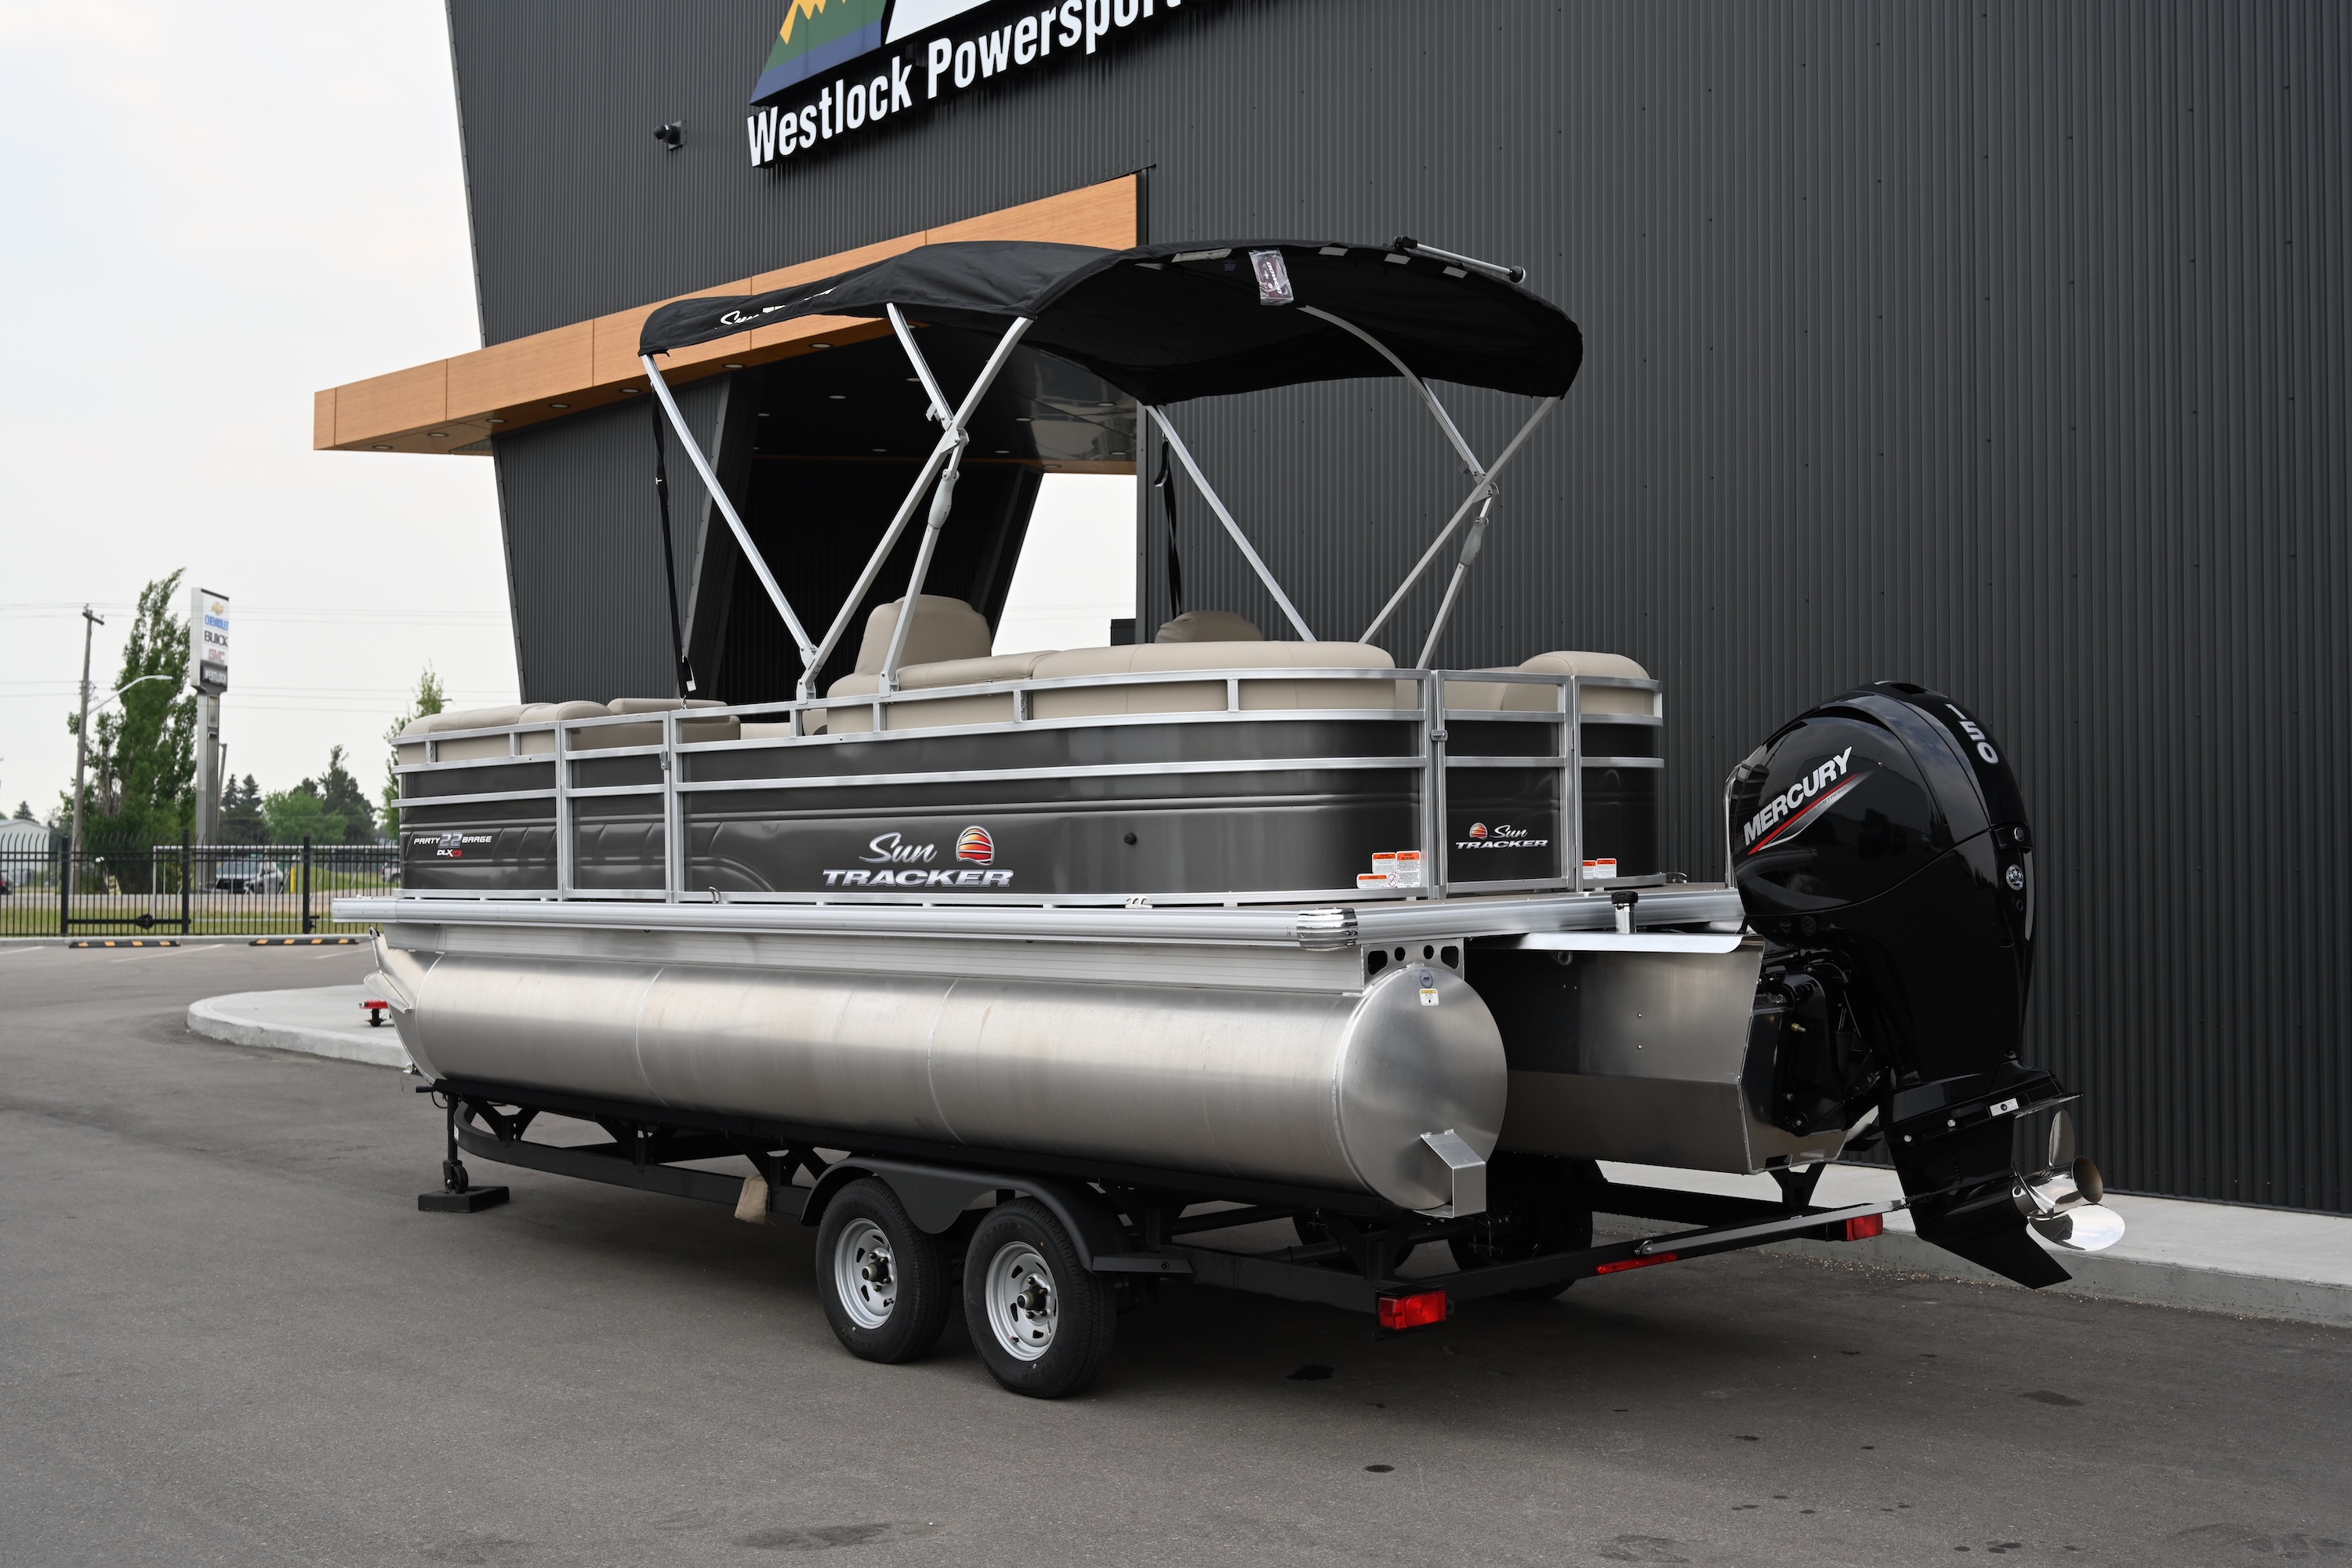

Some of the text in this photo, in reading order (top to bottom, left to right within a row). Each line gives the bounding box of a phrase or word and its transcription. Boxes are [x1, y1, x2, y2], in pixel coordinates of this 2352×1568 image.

[746, 56, 913, 168] Westlock
[205, 615, 229, 631] CHEVROLET
[205, 630, 228, 647] BUICK
[209, 648, 226, 663] GMC
[205, 670, 227, 684] WESTLOCK
[1945, 703, 1999, 764] 150
[1743, 746, 1852, 846] MERCURY
[1489, 824, 1528, 838] Sun
[438, 832, 463, 848] 22
[858, 832, 938, 863] Sun
[1455, 840, 1548, 849] TRACKER
[822, 869, 1014, 887] TRACKER
